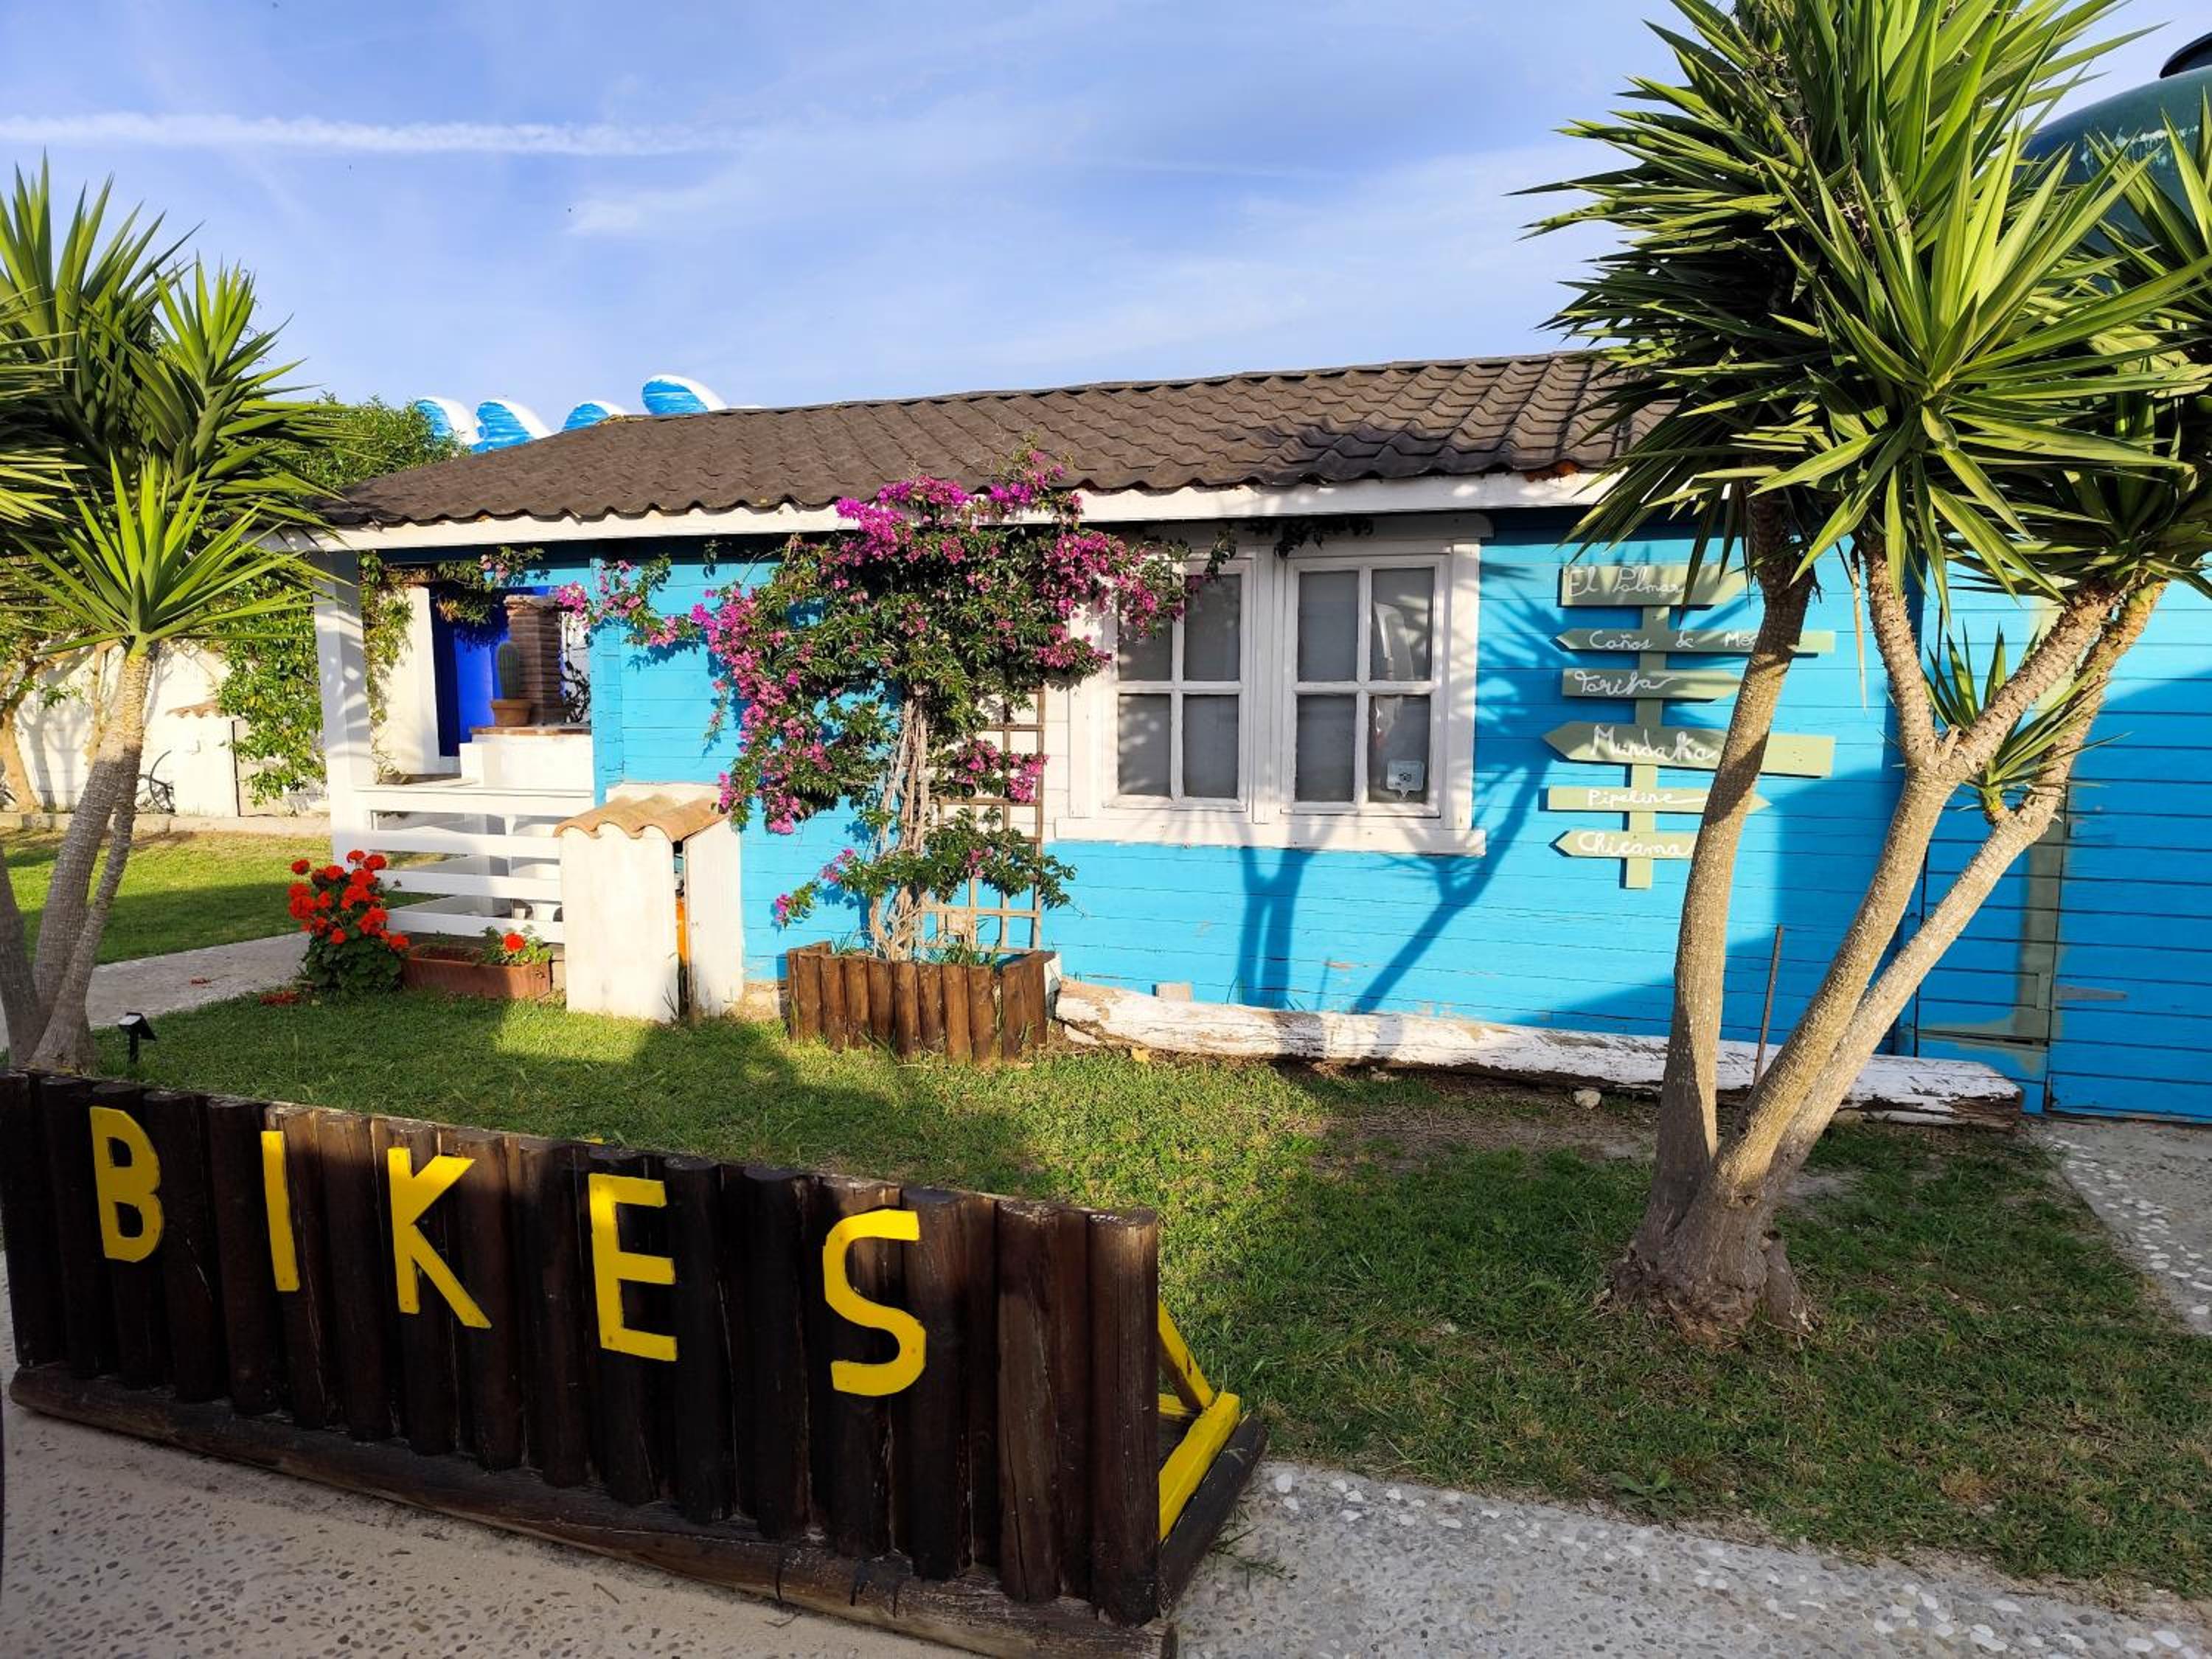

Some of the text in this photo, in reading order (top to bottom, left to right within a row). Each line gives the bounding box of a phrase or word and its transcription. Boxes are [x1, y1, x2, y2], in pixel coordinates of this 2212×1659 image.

[1569, 566, 1599, 597] El
[1675, 631, 1696, 649] de
[1574, 672, 1677, 695] Tarifa
[1587, 790, 1708, 807] Pipeline
[1577, 832, 1696, 857] Chicama
[90, 1106, 926, 1396] BIKES
